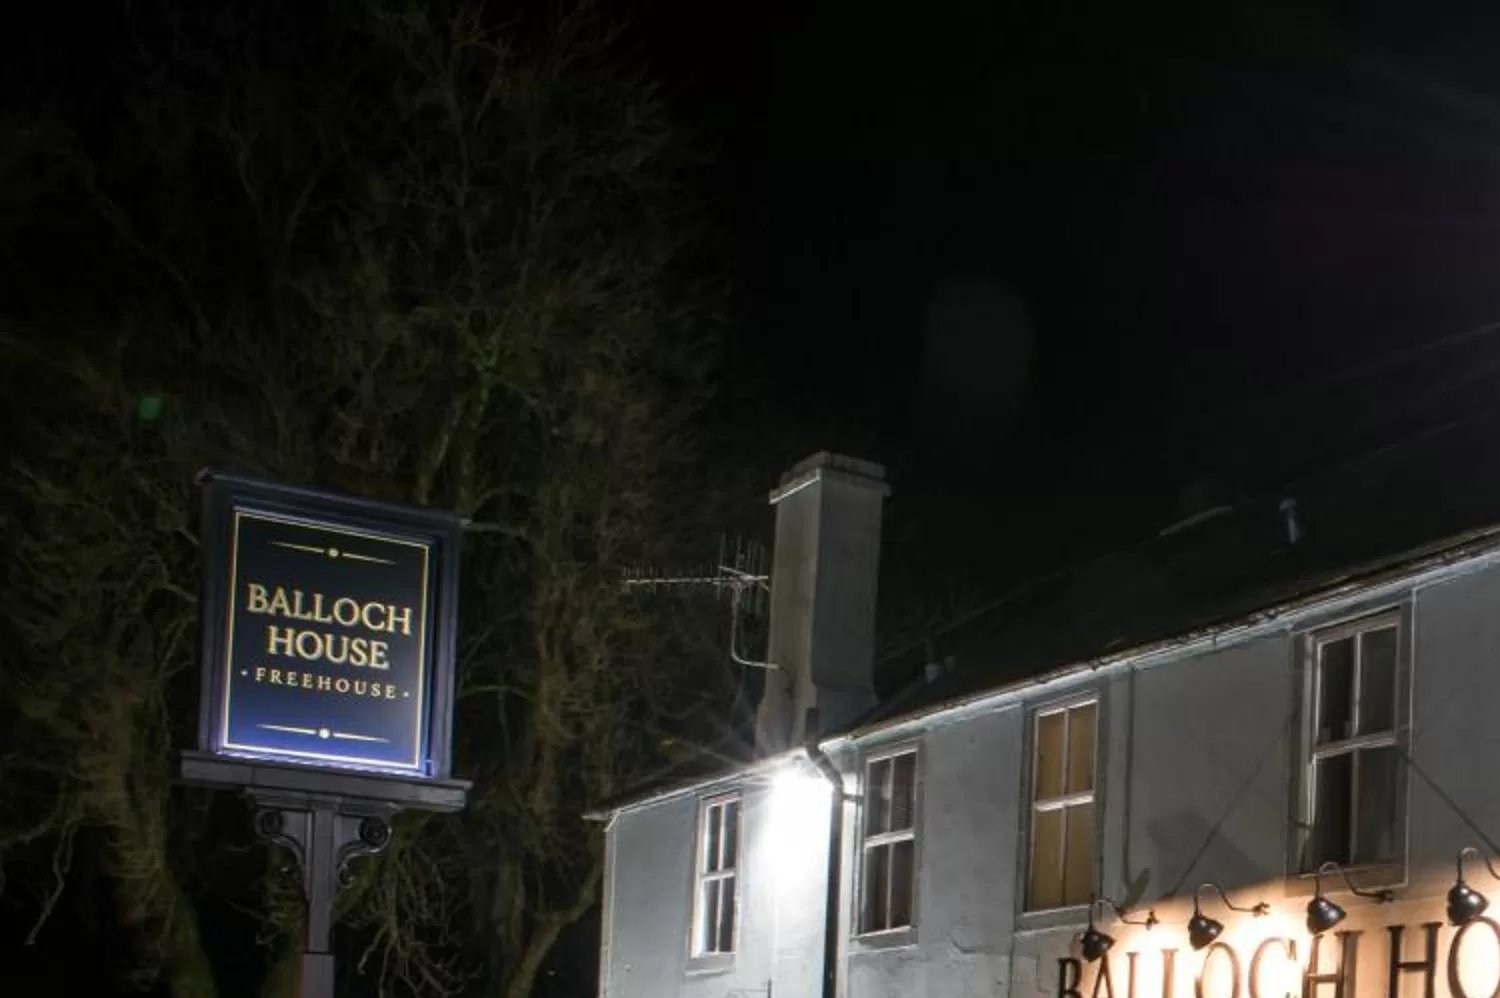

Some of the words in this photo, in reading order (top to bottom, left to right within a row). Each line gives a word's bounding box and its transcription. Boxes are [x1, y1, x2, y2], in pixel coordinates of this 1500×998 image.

[246, 583, 413, 636] BALLOCH
[266, 625, 390, 671] HOUSE
[255, 667, 397, 699] FREEHOUSE
